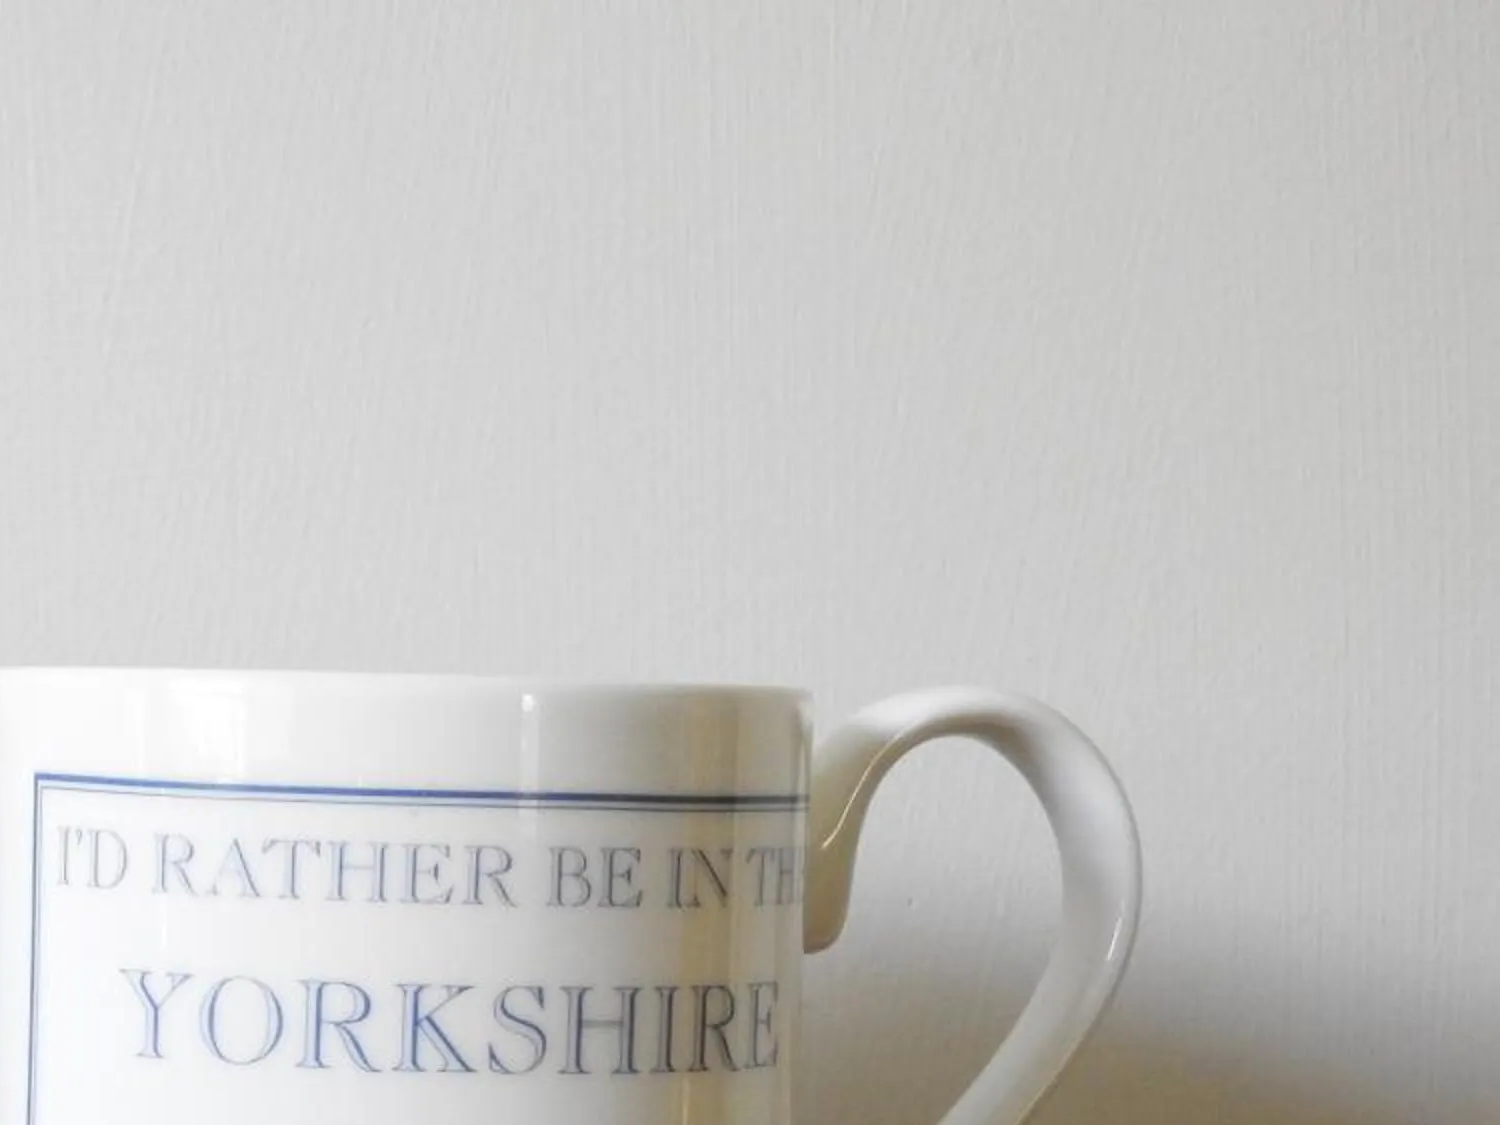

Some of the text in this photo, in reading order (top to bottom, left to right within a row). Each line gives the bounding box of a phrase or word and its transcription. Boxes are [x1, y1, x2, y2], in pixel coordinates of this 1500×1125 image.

[56, 824, 129, 890] I'D
[151, 832, 516, 908] RATHER
[546, 846, 643, 908] BE
[666, 847, 734, 909] IN
[119, 968, 780, 1075] YORKSHIRE
